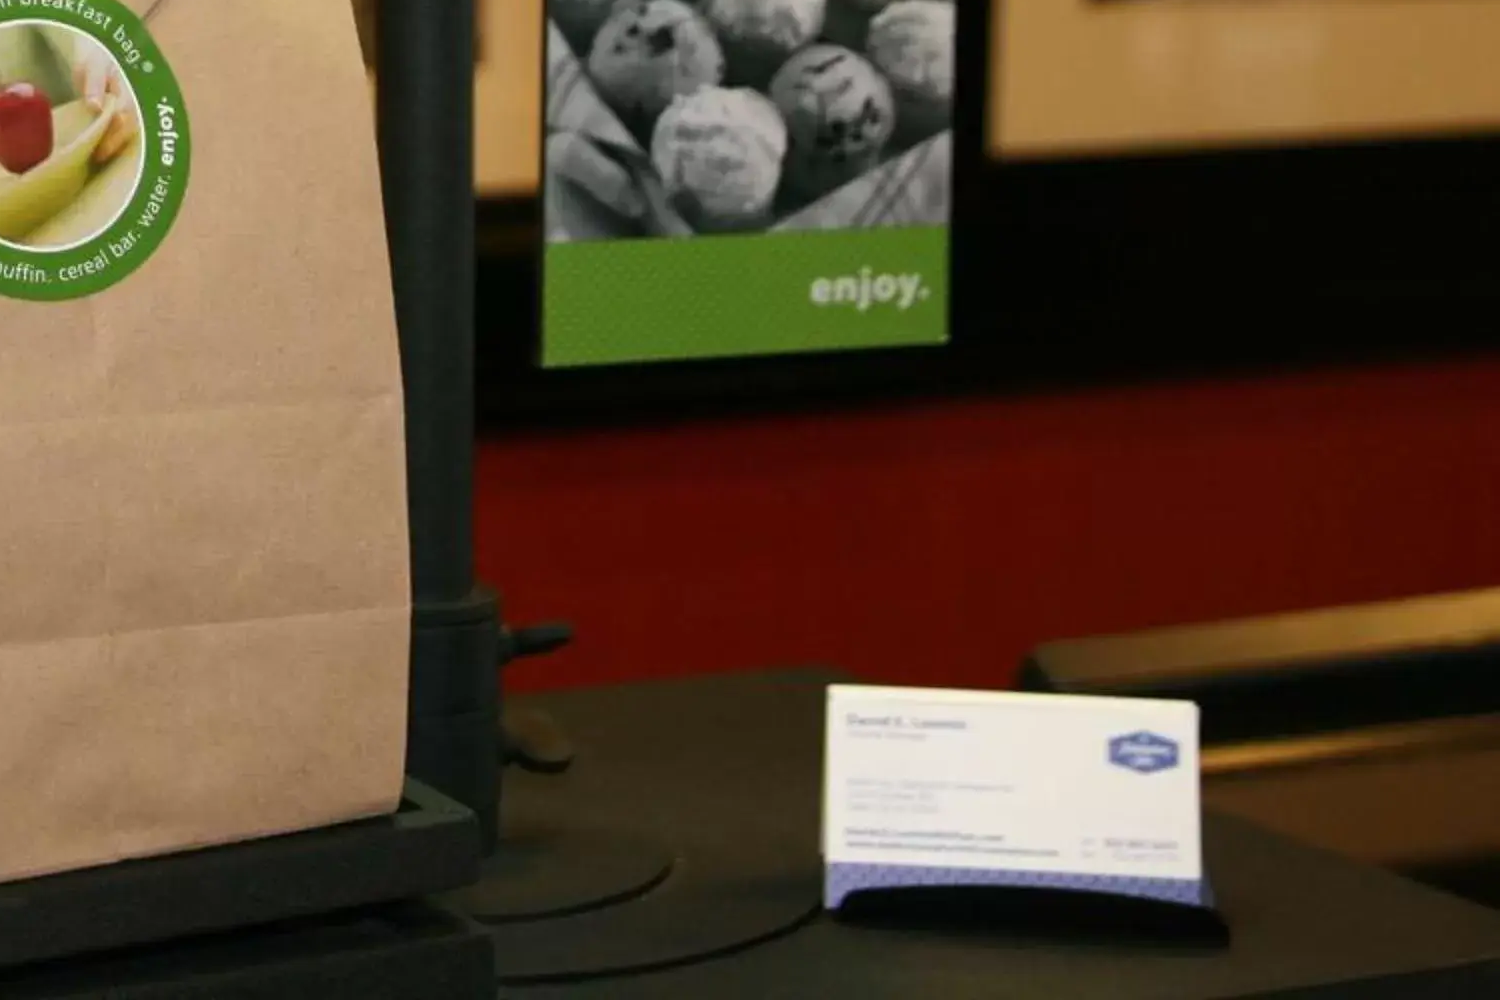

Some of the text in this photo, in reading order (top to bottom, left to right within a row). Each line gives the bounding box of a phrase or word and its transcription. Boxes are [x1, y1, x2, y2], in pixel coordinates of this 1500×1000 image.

[59, 250, 110, 282] cereal
[108, 230, 141, 258] bar.
[137, 174, 172, 227] water.
[157, 96, 179, 166] enjoy.
[810, 267, 930, 311] enjoy.
